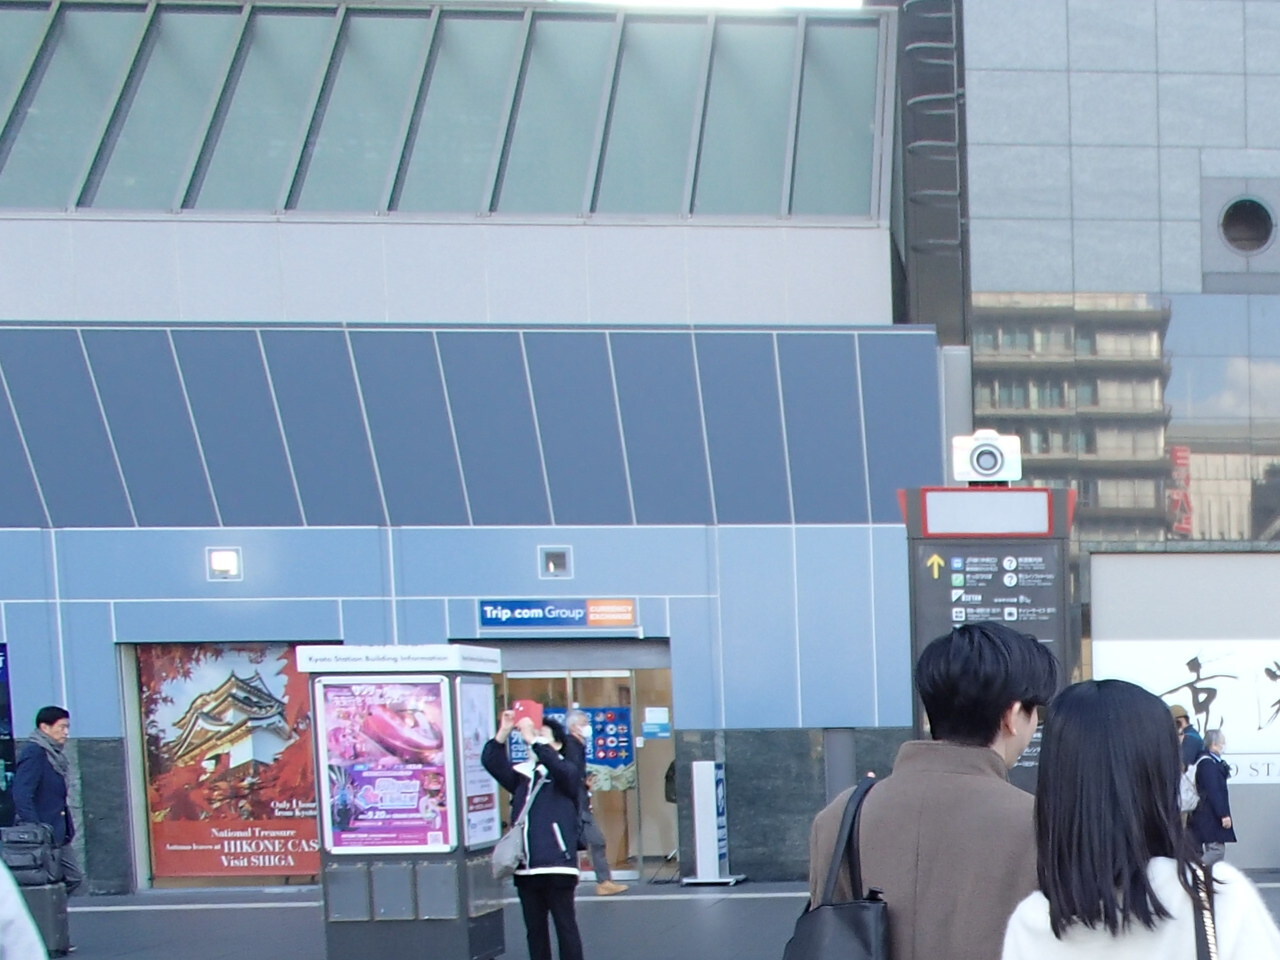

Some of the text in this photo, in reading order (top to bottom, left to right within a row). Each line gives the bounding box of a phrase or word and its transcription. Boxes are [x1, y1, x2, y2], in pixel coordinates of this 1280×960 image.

[545, 605, 584, 621] Group
[365, 655, 398, 663] Building
[270, 801, 290, 809] Only
[274, 808, 318, 818] from Kyoto
[211, 827, 296, 837] National Treasure
[193, 842, 211, 850] leaves
[223, 840, 284, 853] HIKONE
[221, 854, 295, 867] Visit SHIGA
